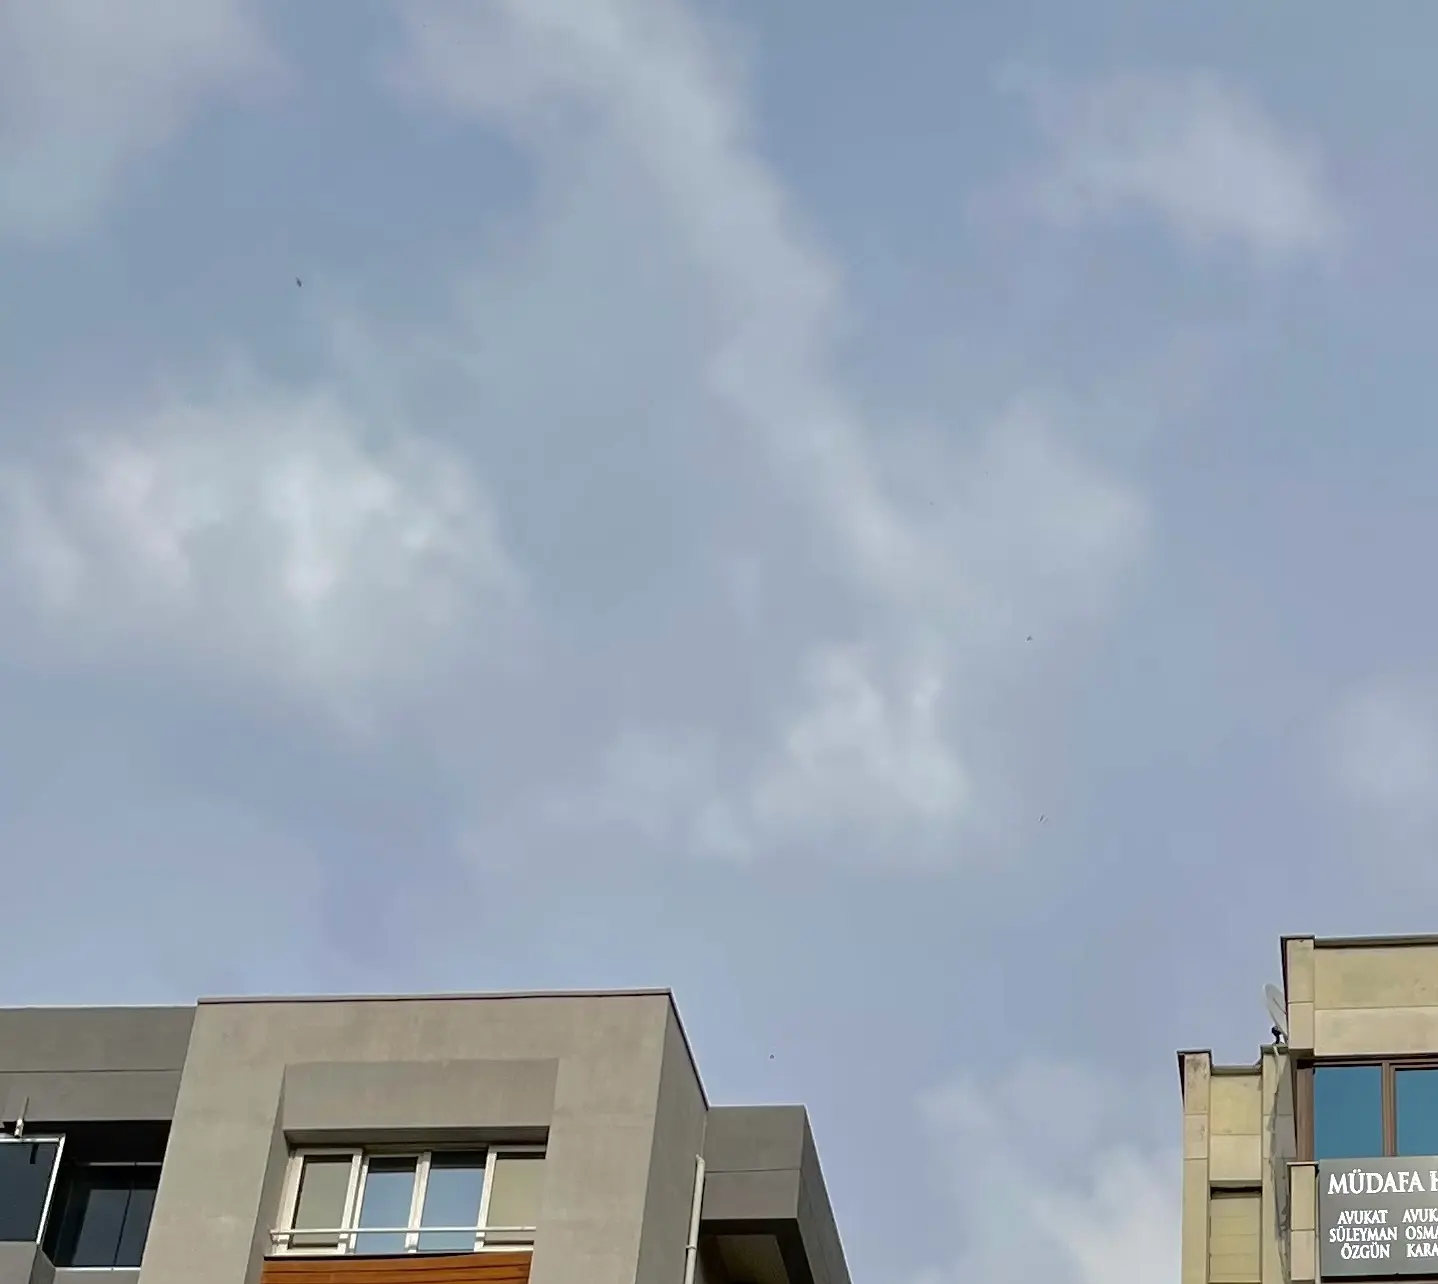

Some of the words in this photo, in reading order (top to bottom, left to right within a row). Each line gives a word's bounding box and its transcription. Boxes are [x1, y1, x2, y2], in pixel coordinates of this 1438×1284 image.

[1327, 1168, 1425, 1195] MÜDAFA
[1337, 1209, 1389, 1226] AVUKAT
[1329, 1224, 1398, 1244] SÜLEYMAN
[1340, 1241, 1391, 1260] ÖZGÜN
